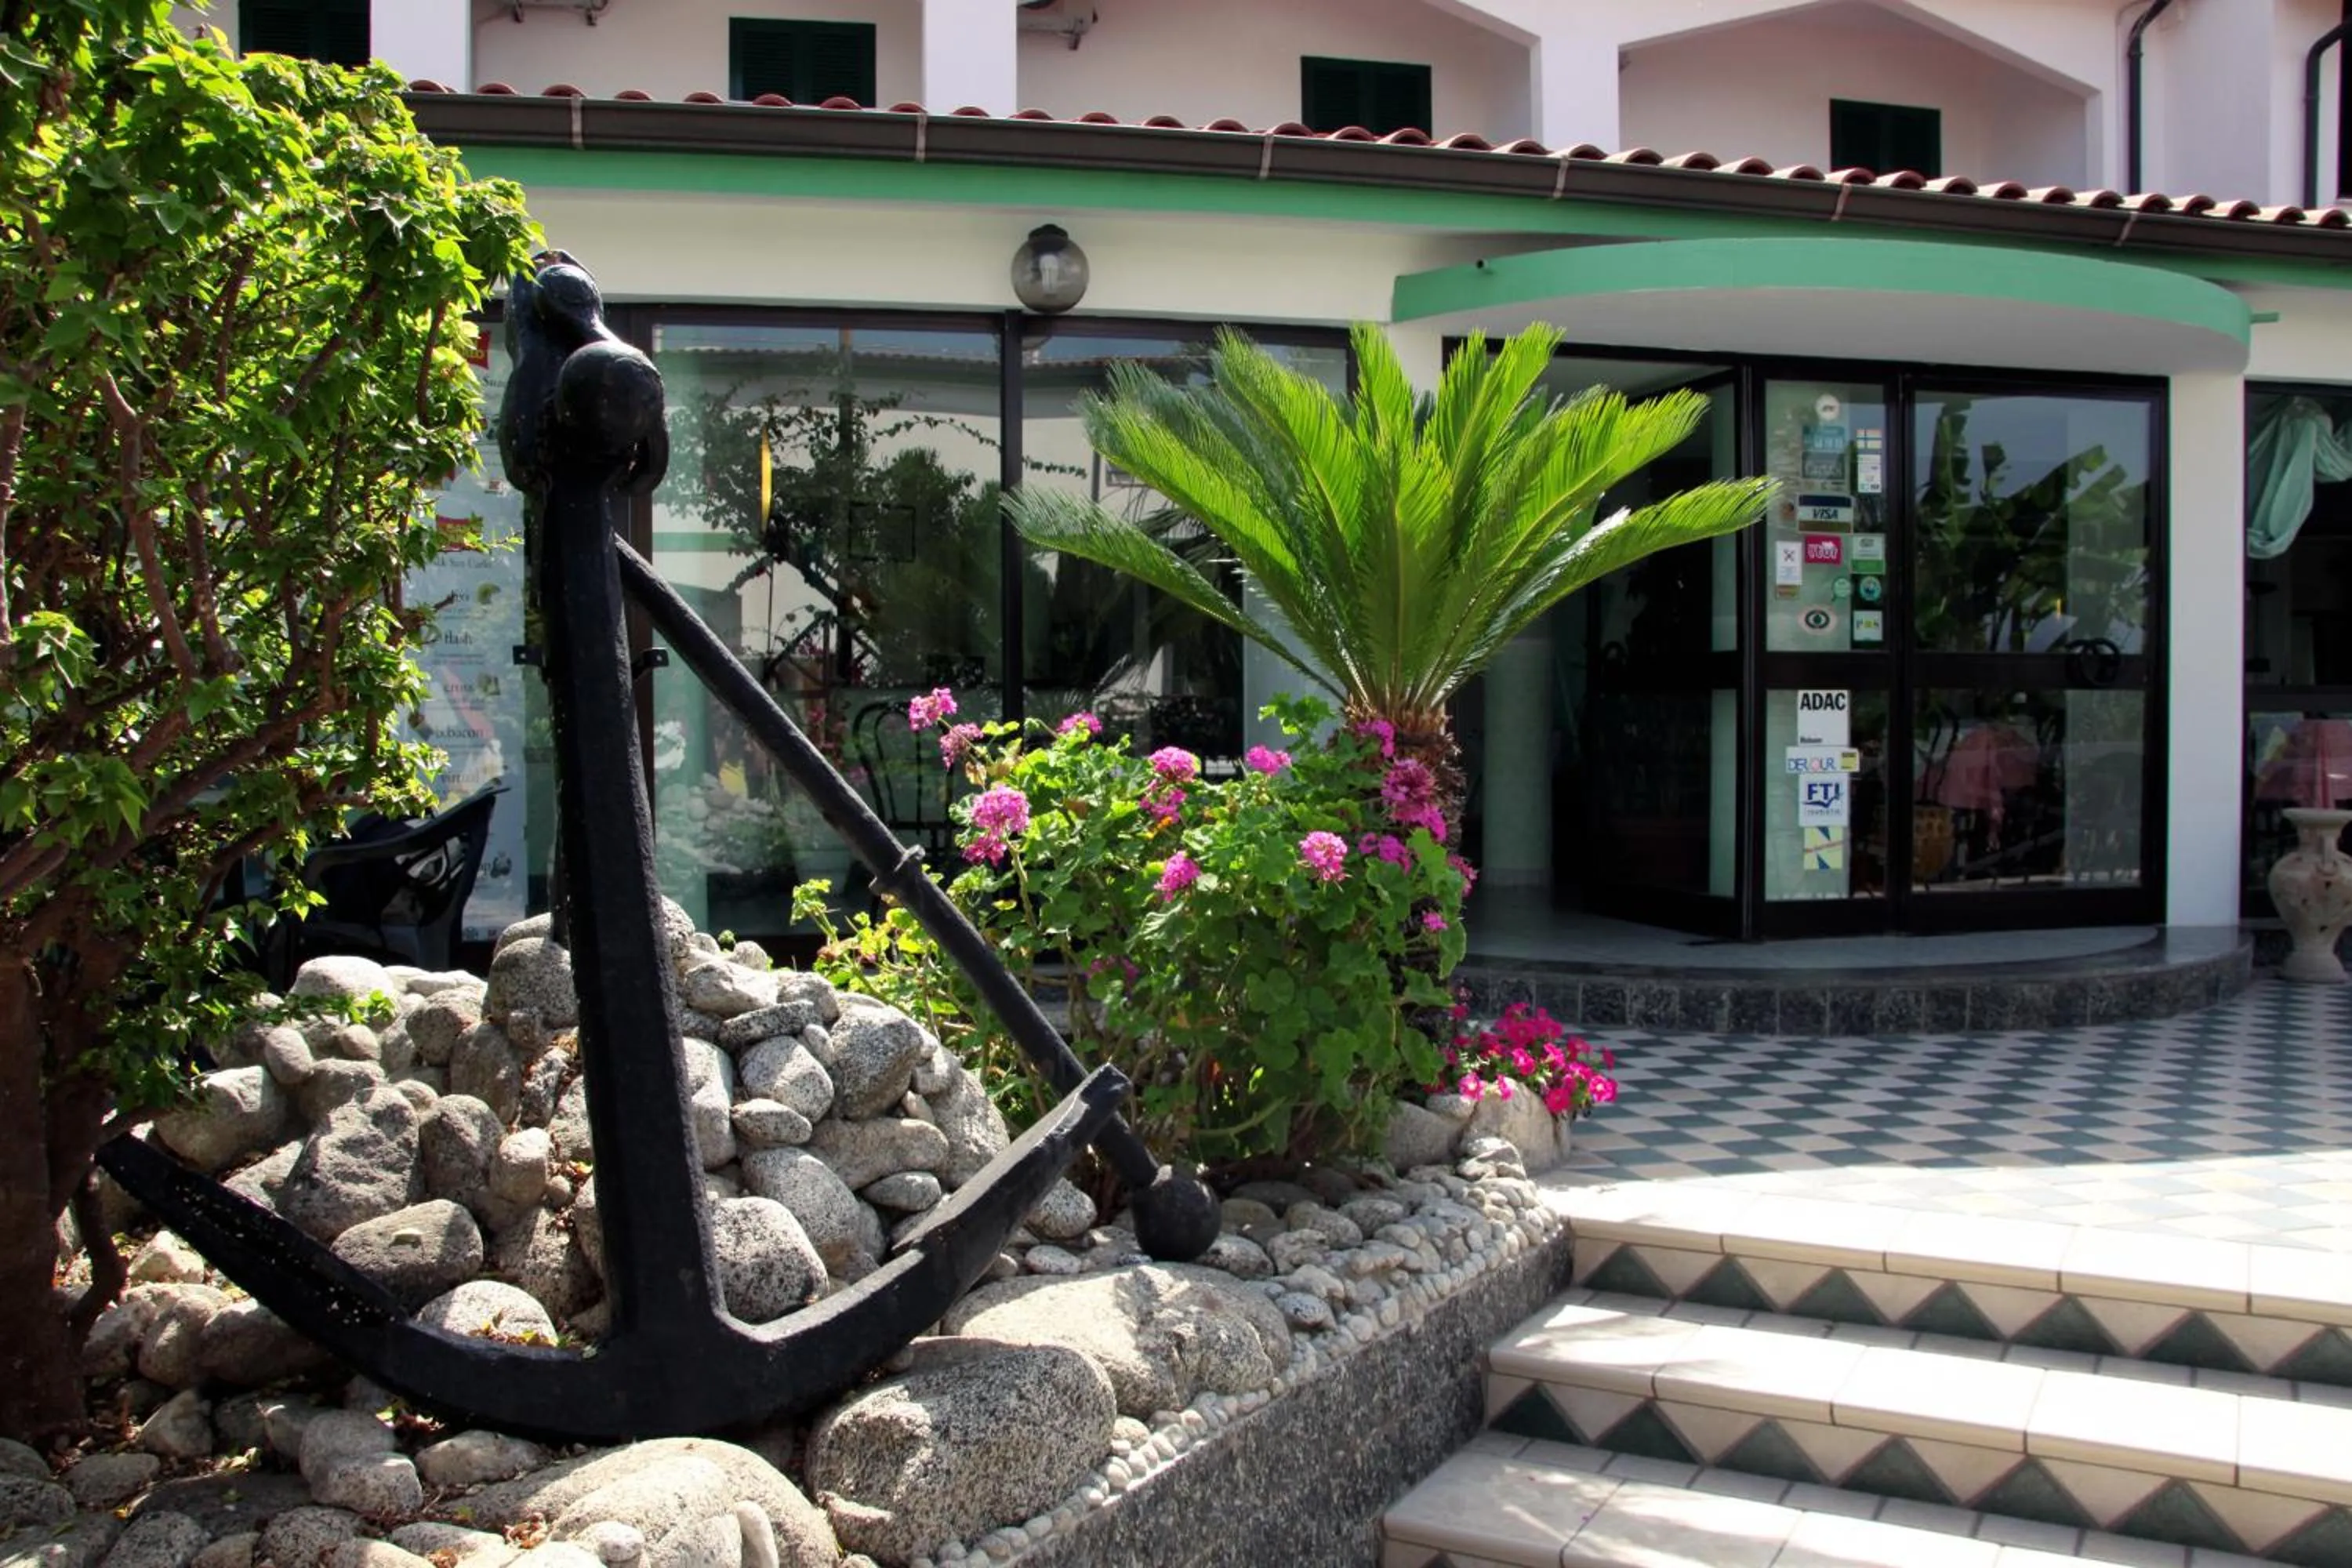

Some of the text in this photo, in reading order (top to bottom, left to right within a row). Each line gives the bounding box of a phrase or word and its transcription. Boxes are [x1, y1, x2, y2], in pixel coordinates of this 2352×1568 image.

[1813, 508, 1838, 519] VISA
[1800, 692, 1846, 710] ADAC
[1807, 782, 1840, 800] FTI
